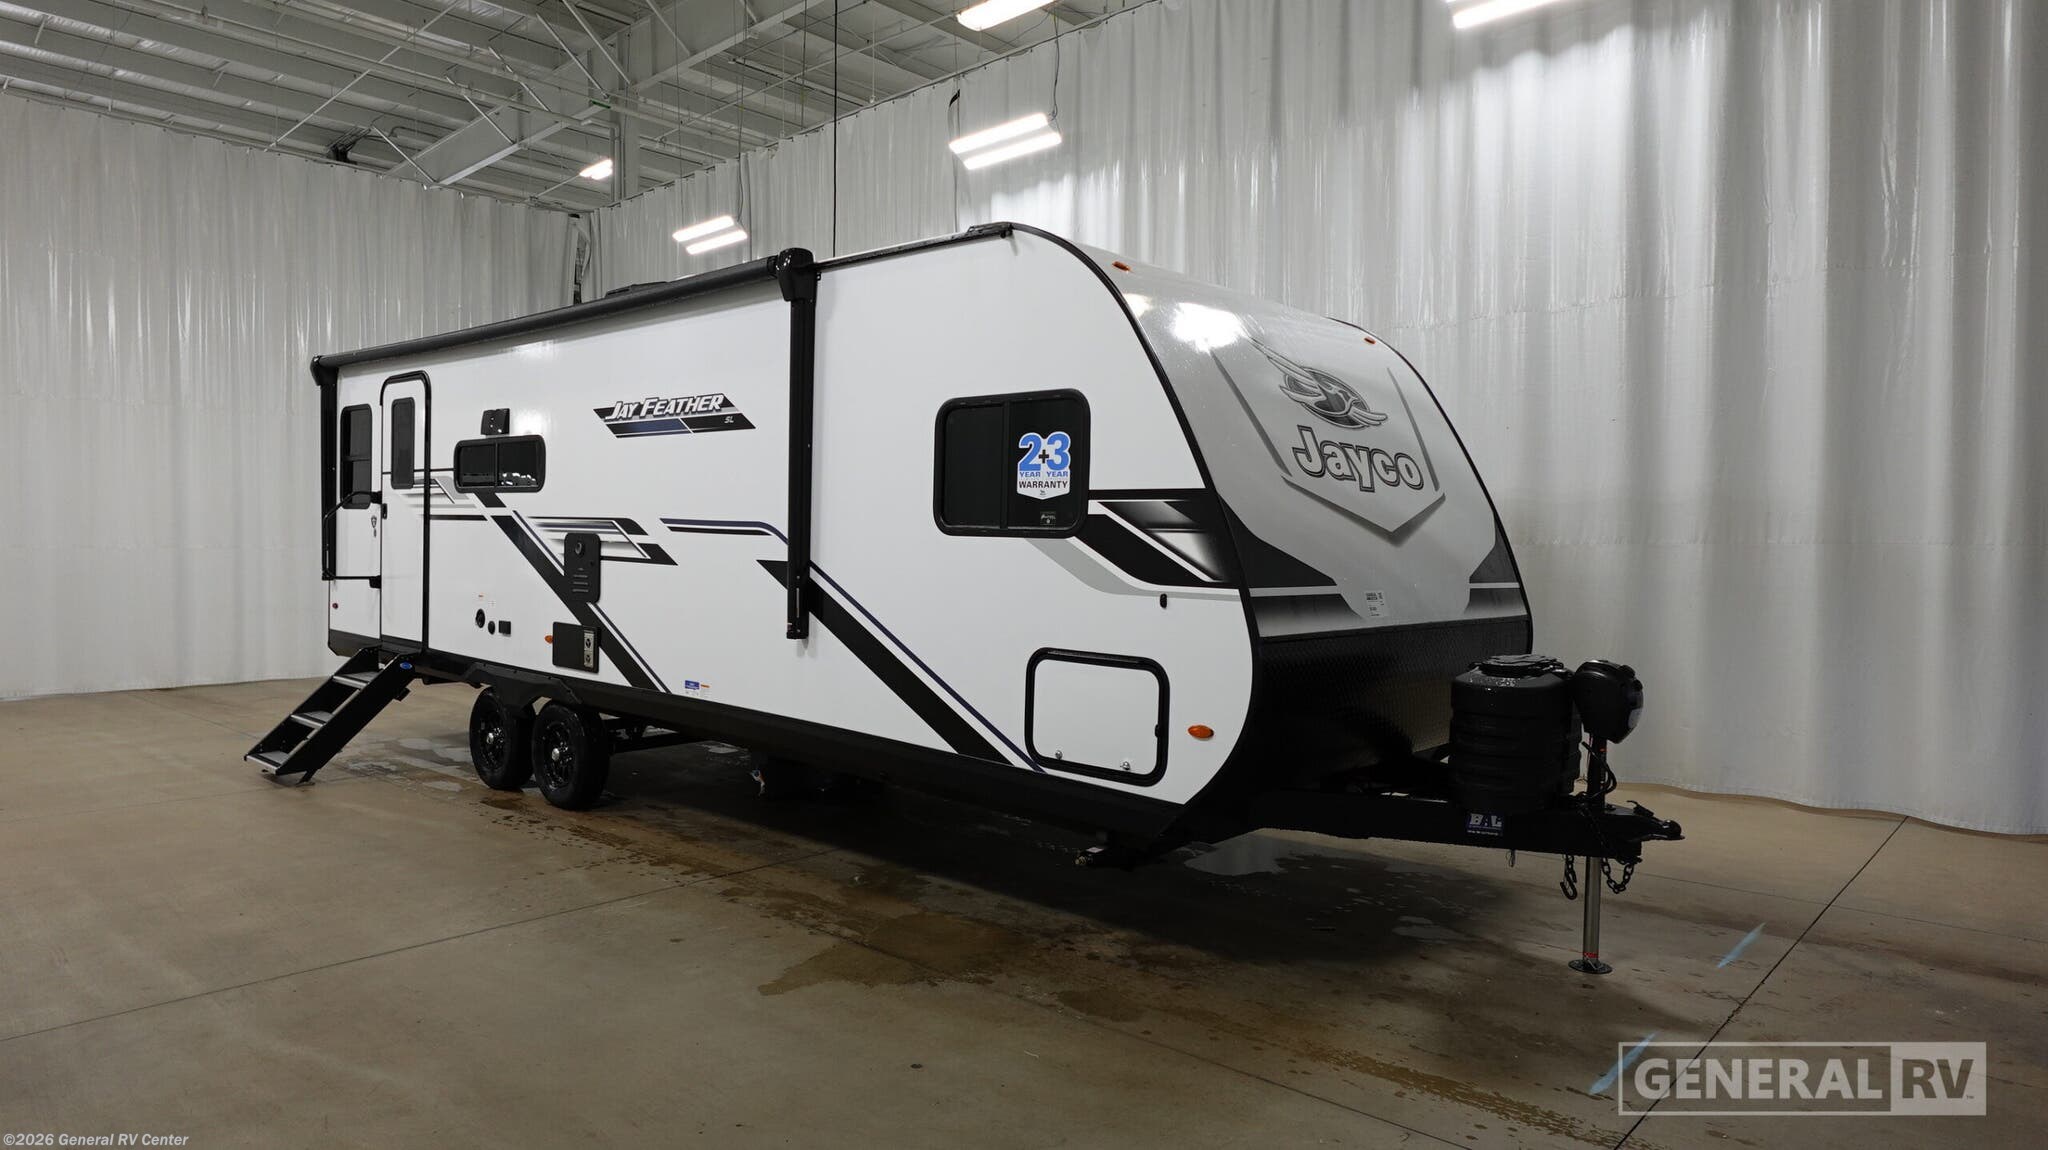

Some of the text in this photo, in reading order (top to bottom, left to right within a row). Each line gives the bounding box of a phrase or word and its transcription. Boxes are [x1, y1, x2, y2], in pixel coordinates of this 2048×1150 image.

[604, 394, 724, 421] JAY FEATHER
[723, 415, 735, 424] SL
[1292, 425, 1424, 493] Jayco
[1019, 480, 1068, 489] WARRANTY
